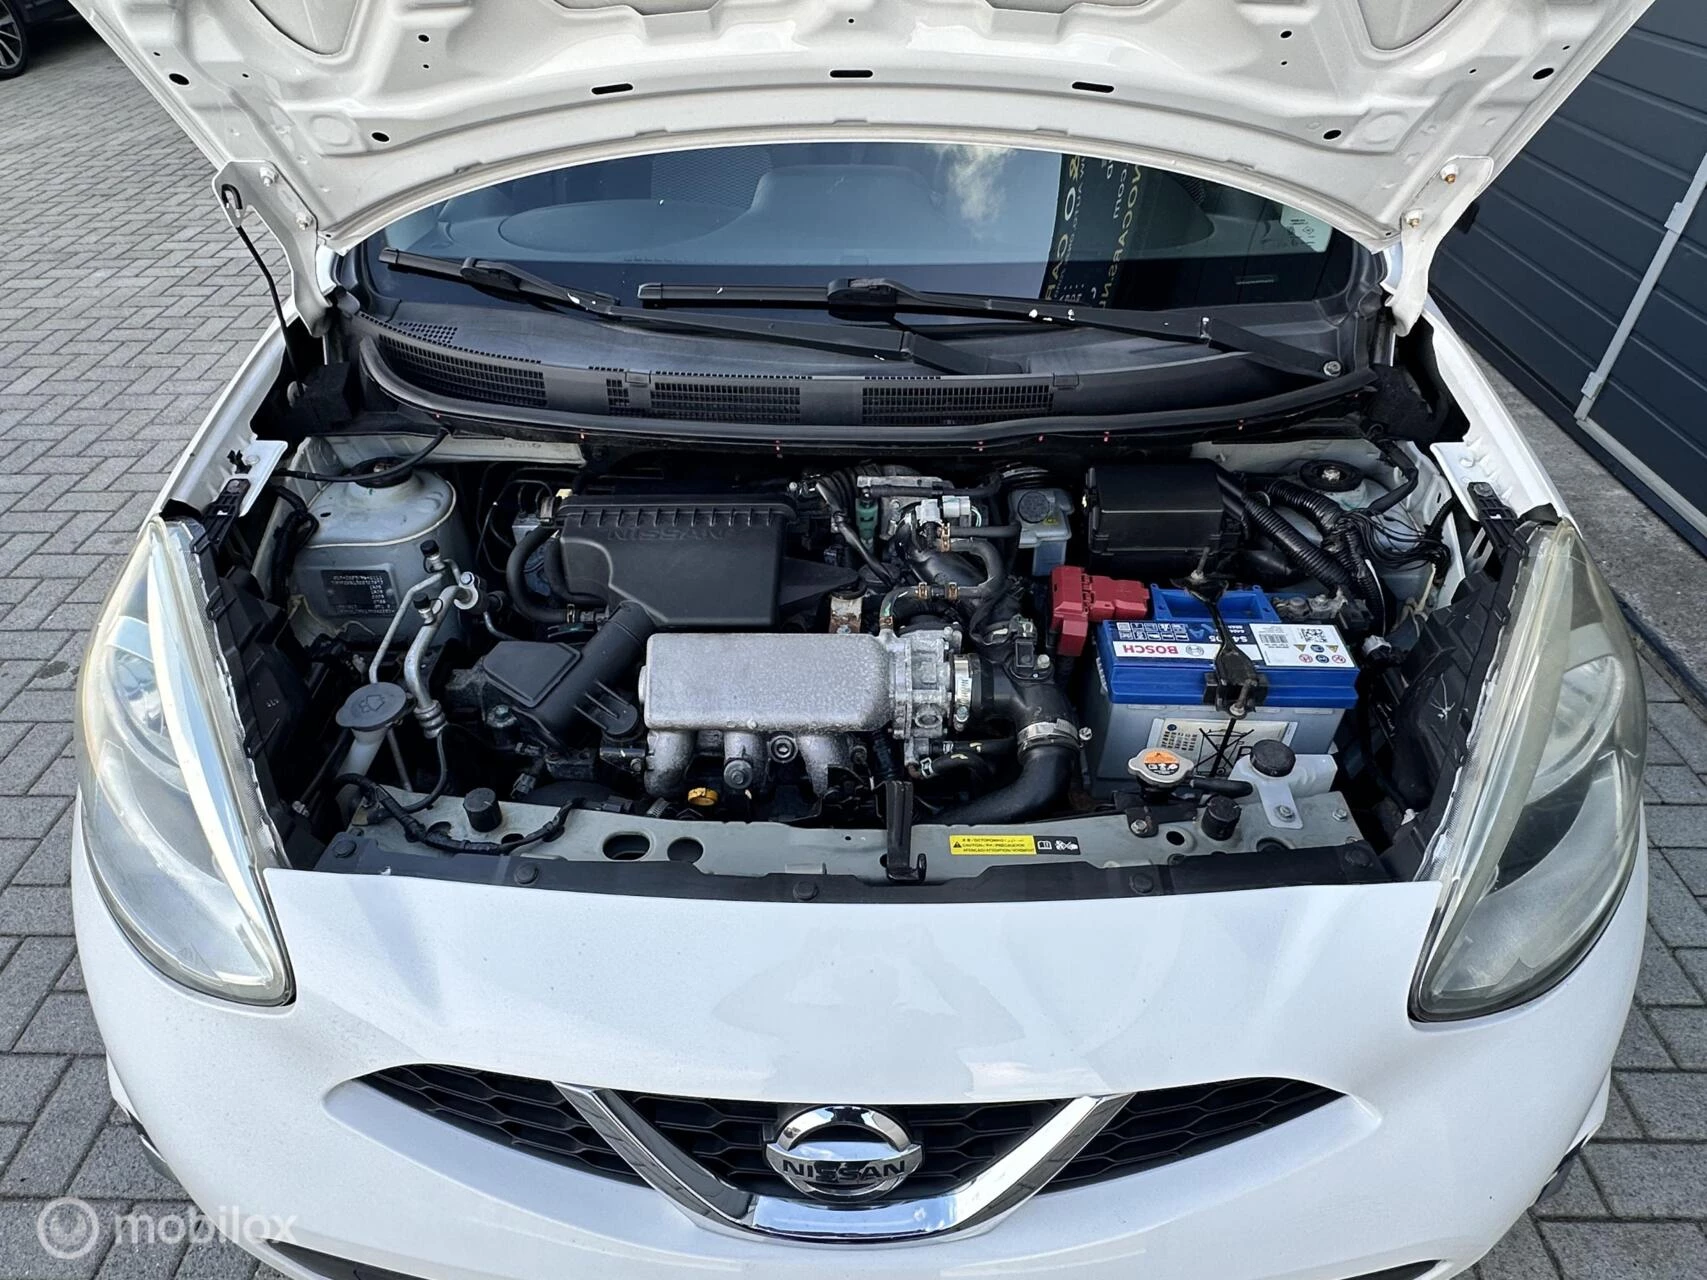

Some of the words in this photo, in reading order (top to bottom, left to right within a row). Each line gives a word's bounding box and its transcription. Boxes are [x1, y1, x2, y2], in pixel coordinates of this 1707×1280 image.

[608, 528, 725, 541] NISSAN
[1122, 644, 1179, 655] BOSCH
[782, 1159, 906, 1183] NISSAN
